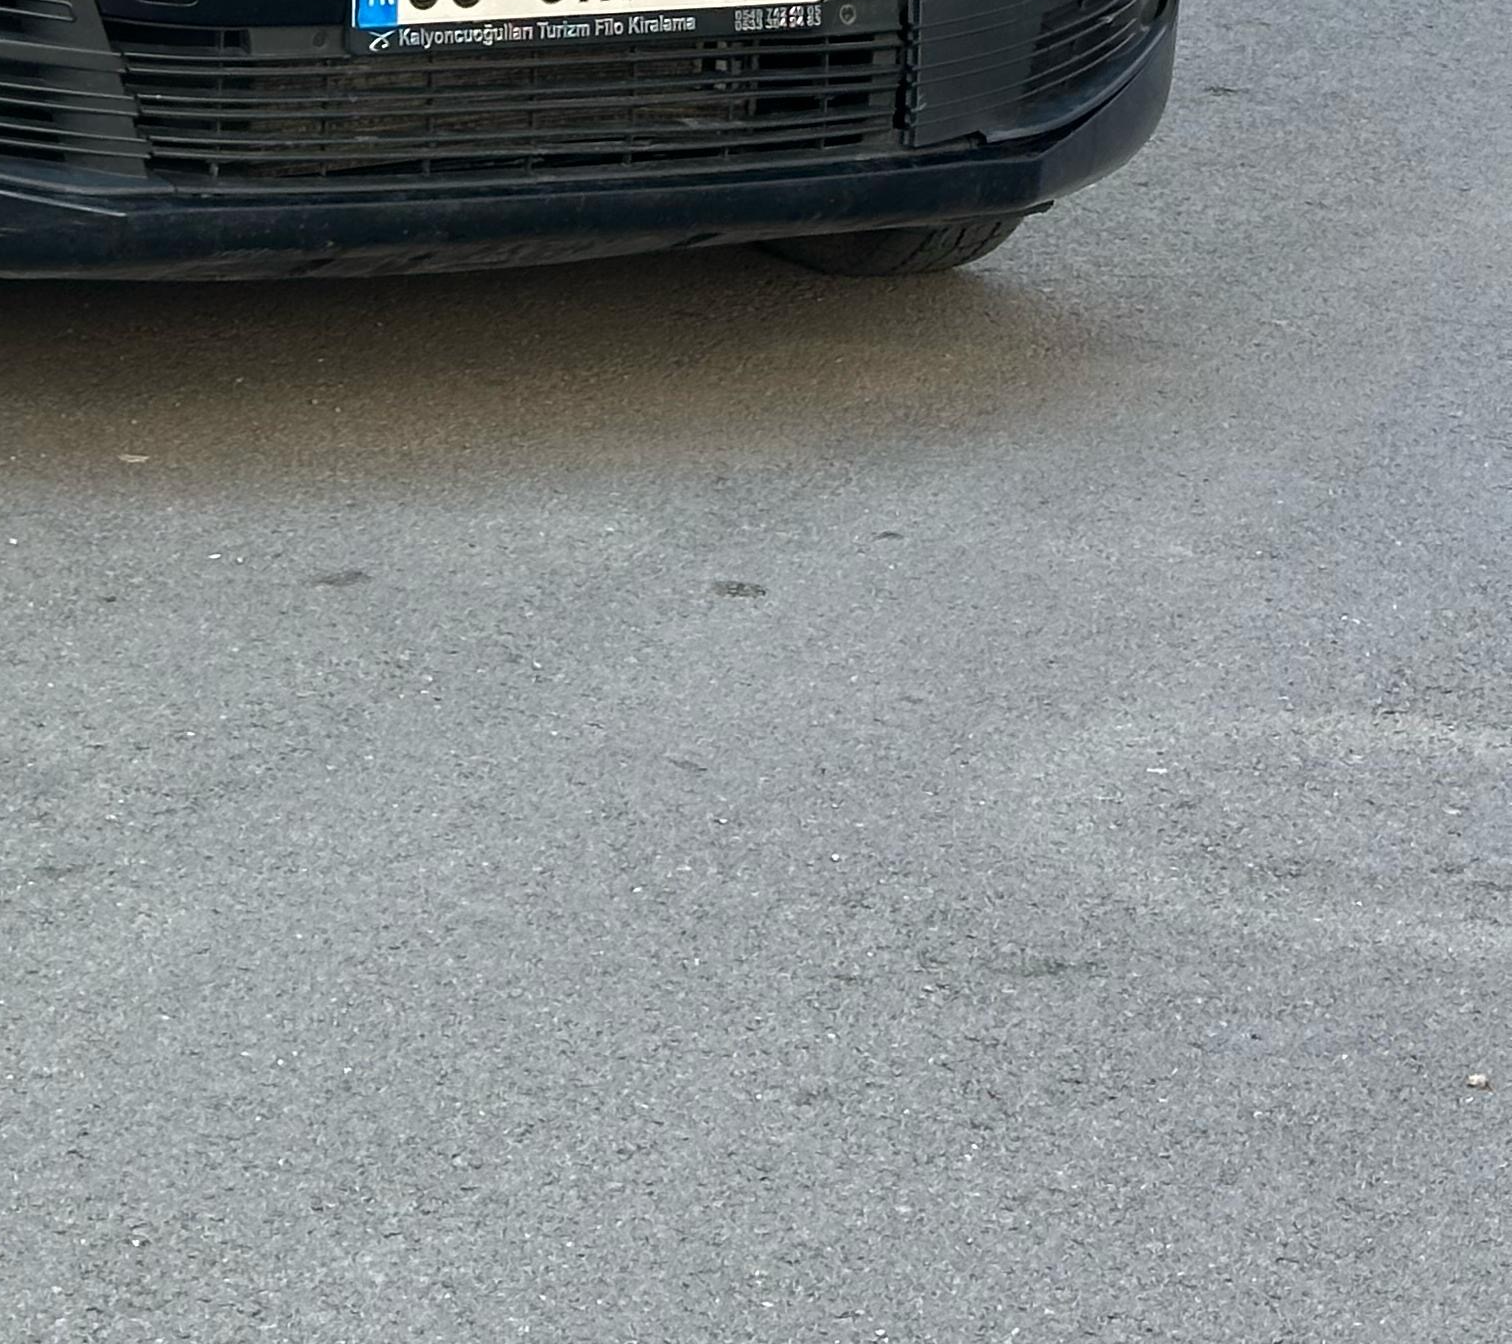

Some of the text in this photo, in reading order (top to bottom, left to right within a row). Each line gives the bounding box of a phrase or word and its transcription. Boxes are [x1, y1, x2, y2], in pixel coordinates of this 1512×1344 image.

[537, 21, 590, 40] Turizm
[595, 18, 623, 36] Filo
[628, 15, 696, 34] Kiralama
